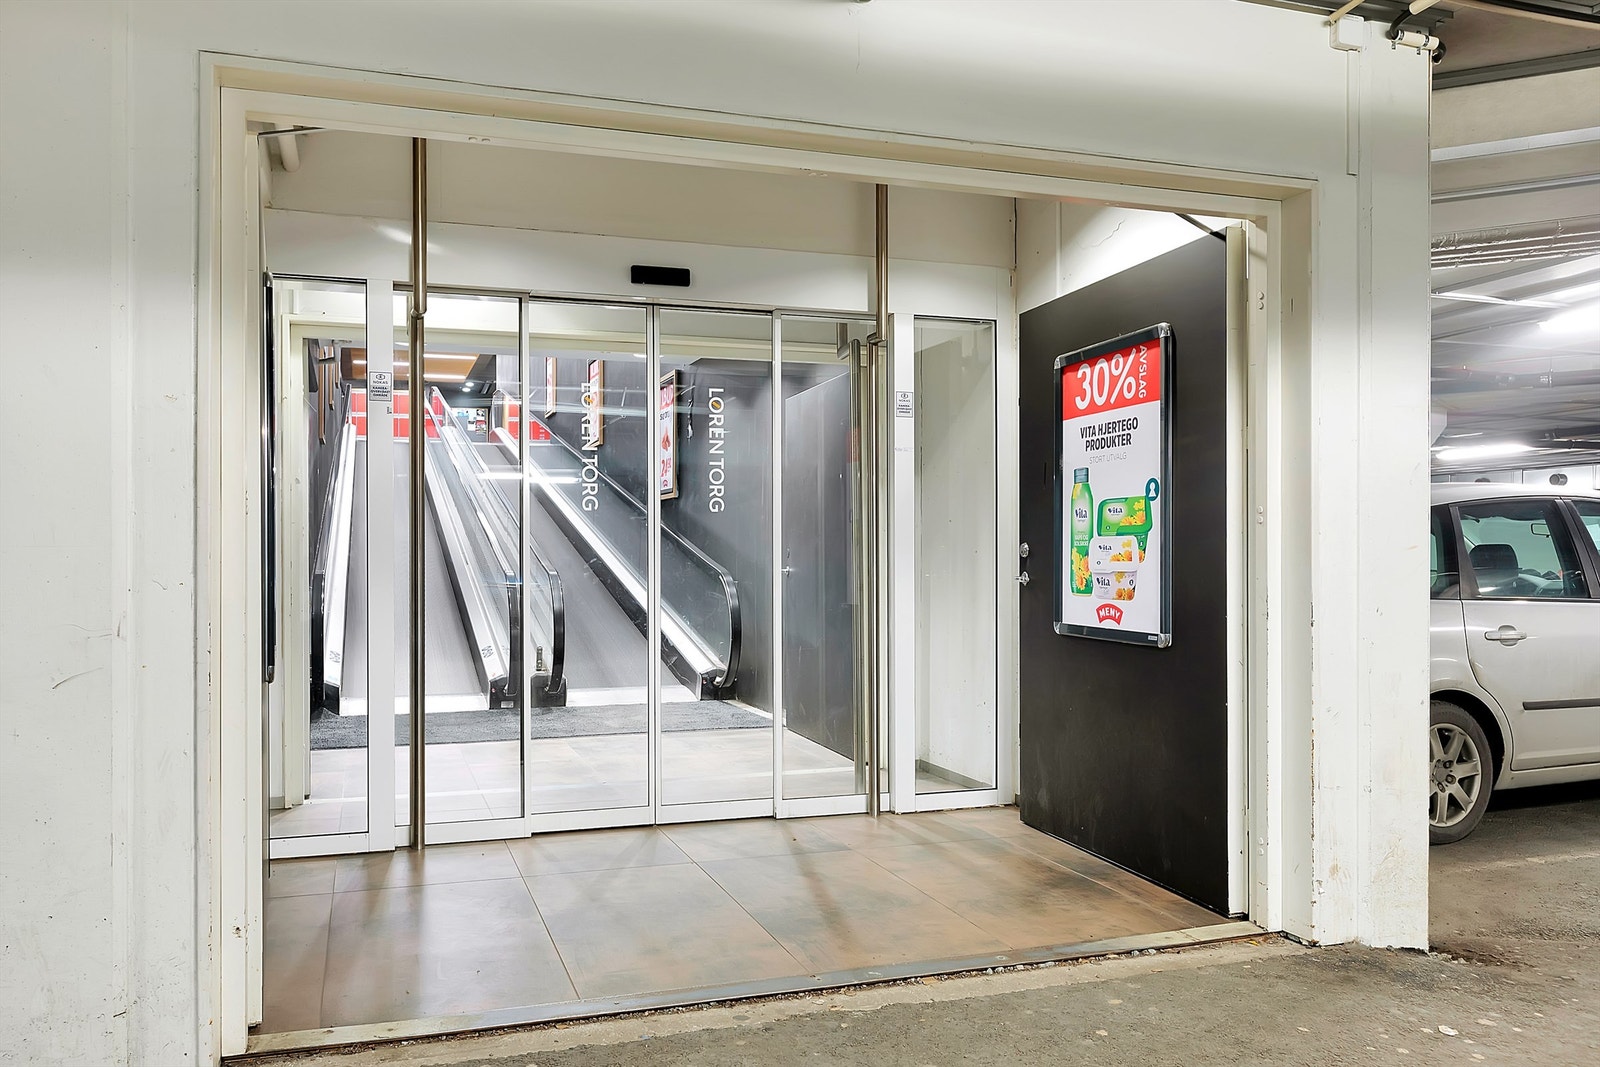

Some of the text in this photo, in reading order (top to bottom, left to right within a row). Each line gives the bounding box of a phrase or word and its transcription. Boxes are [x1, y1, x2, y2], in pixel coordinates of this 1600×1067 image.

[1075, 348, 1137, 410] 30%
[1138, 345, 1148, 398] AVSLAG
[1080, 417, 1139, 439] VITA HJERTEGO
[1085, 432, 1132, 452] PRODUKTER
[1089, 451, 1127, 465] STORT UTVALG
[581, 454, 599, 512] TORG
[708, 458, 725, 513] TORG
[1099, 607, 1121, 620] MENY
